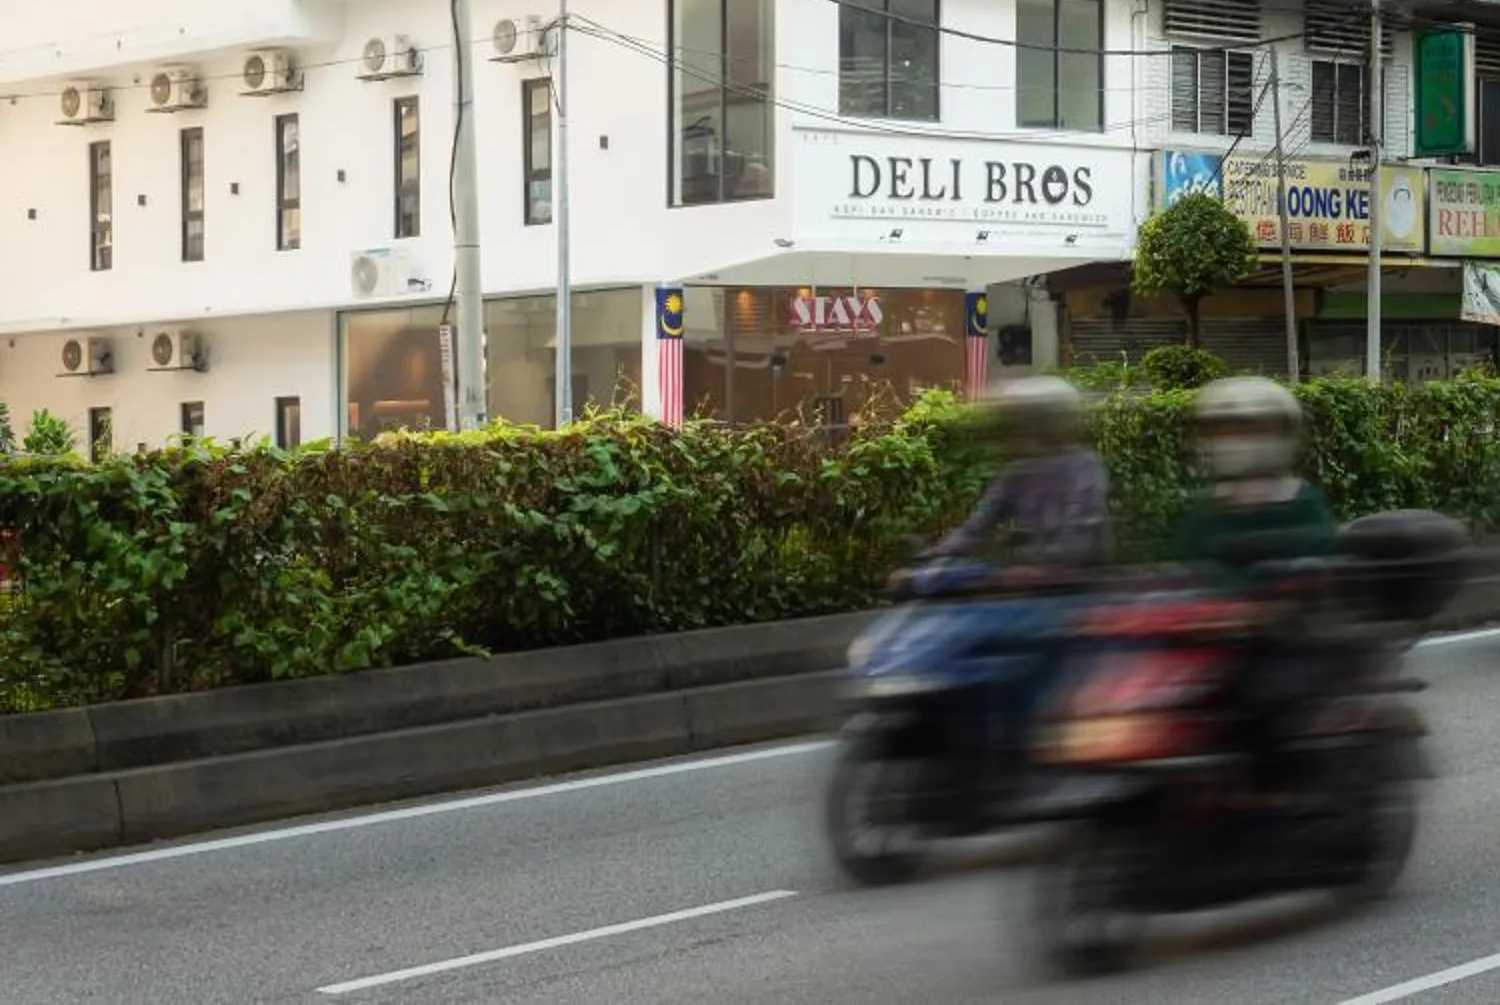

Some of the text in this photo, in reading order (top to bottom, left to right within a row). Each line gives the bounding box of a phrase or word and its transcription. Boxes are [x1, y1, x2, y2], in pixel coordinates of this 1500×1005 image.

[850, 154, 1094, 207] DELI BROS
[1277, 184, 1341, 220] OONG
[1346, 188, 1371, 220] KE
[790, 295, 883, 326] STAYS
